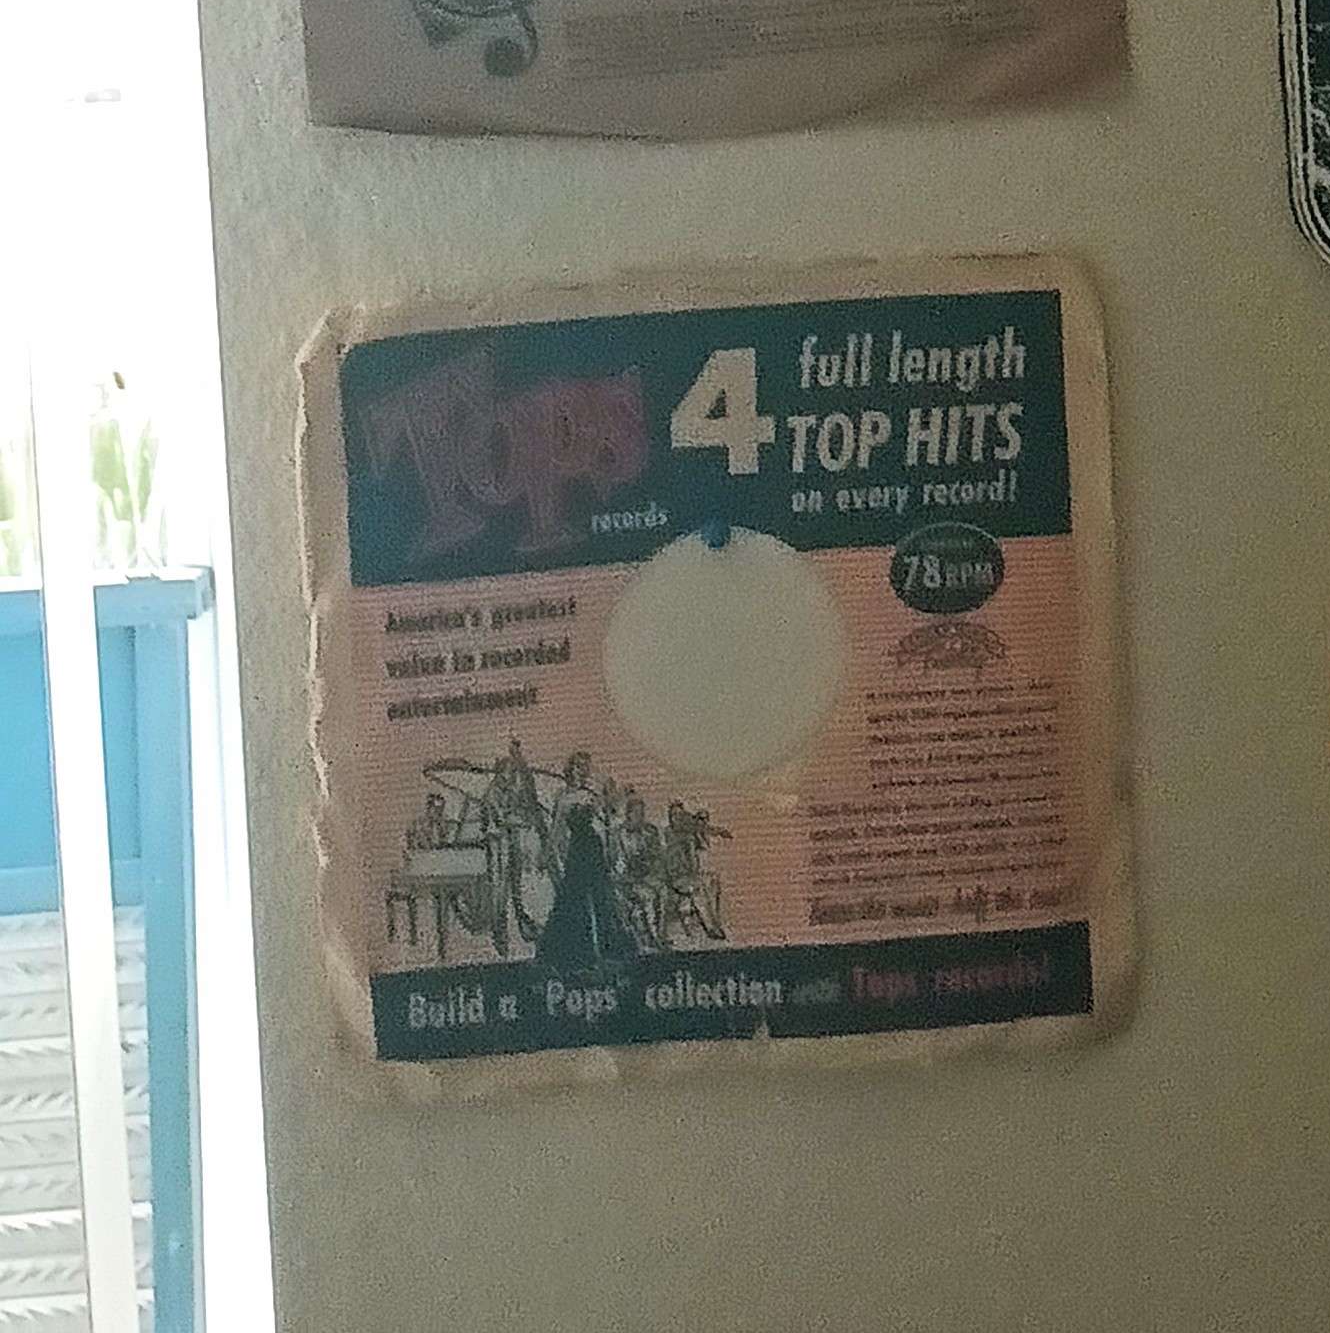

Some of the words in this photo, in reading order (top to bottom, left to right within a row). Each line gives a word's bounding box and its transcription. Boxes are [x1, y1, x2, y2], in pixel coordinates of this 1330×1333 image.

[670, 346, 777, 476] 4
[799, 334, 873, 391] full
[888, 325, 1026, 393] length
[786, 409, 891, 475] TOP
[905, 401, 1025, 467] HITS
[790, 486, 823, 513] on
[836, 481, 910, 517] every
[922, 469, 1019, 507] record!
[902, 553, 943, 591] 78
[946, 560, 996, 589] RPM
[407, 988, 486, 1030] Build
[497, 995, 520, 1021] a
[643, 970, 786, 1013] collection
